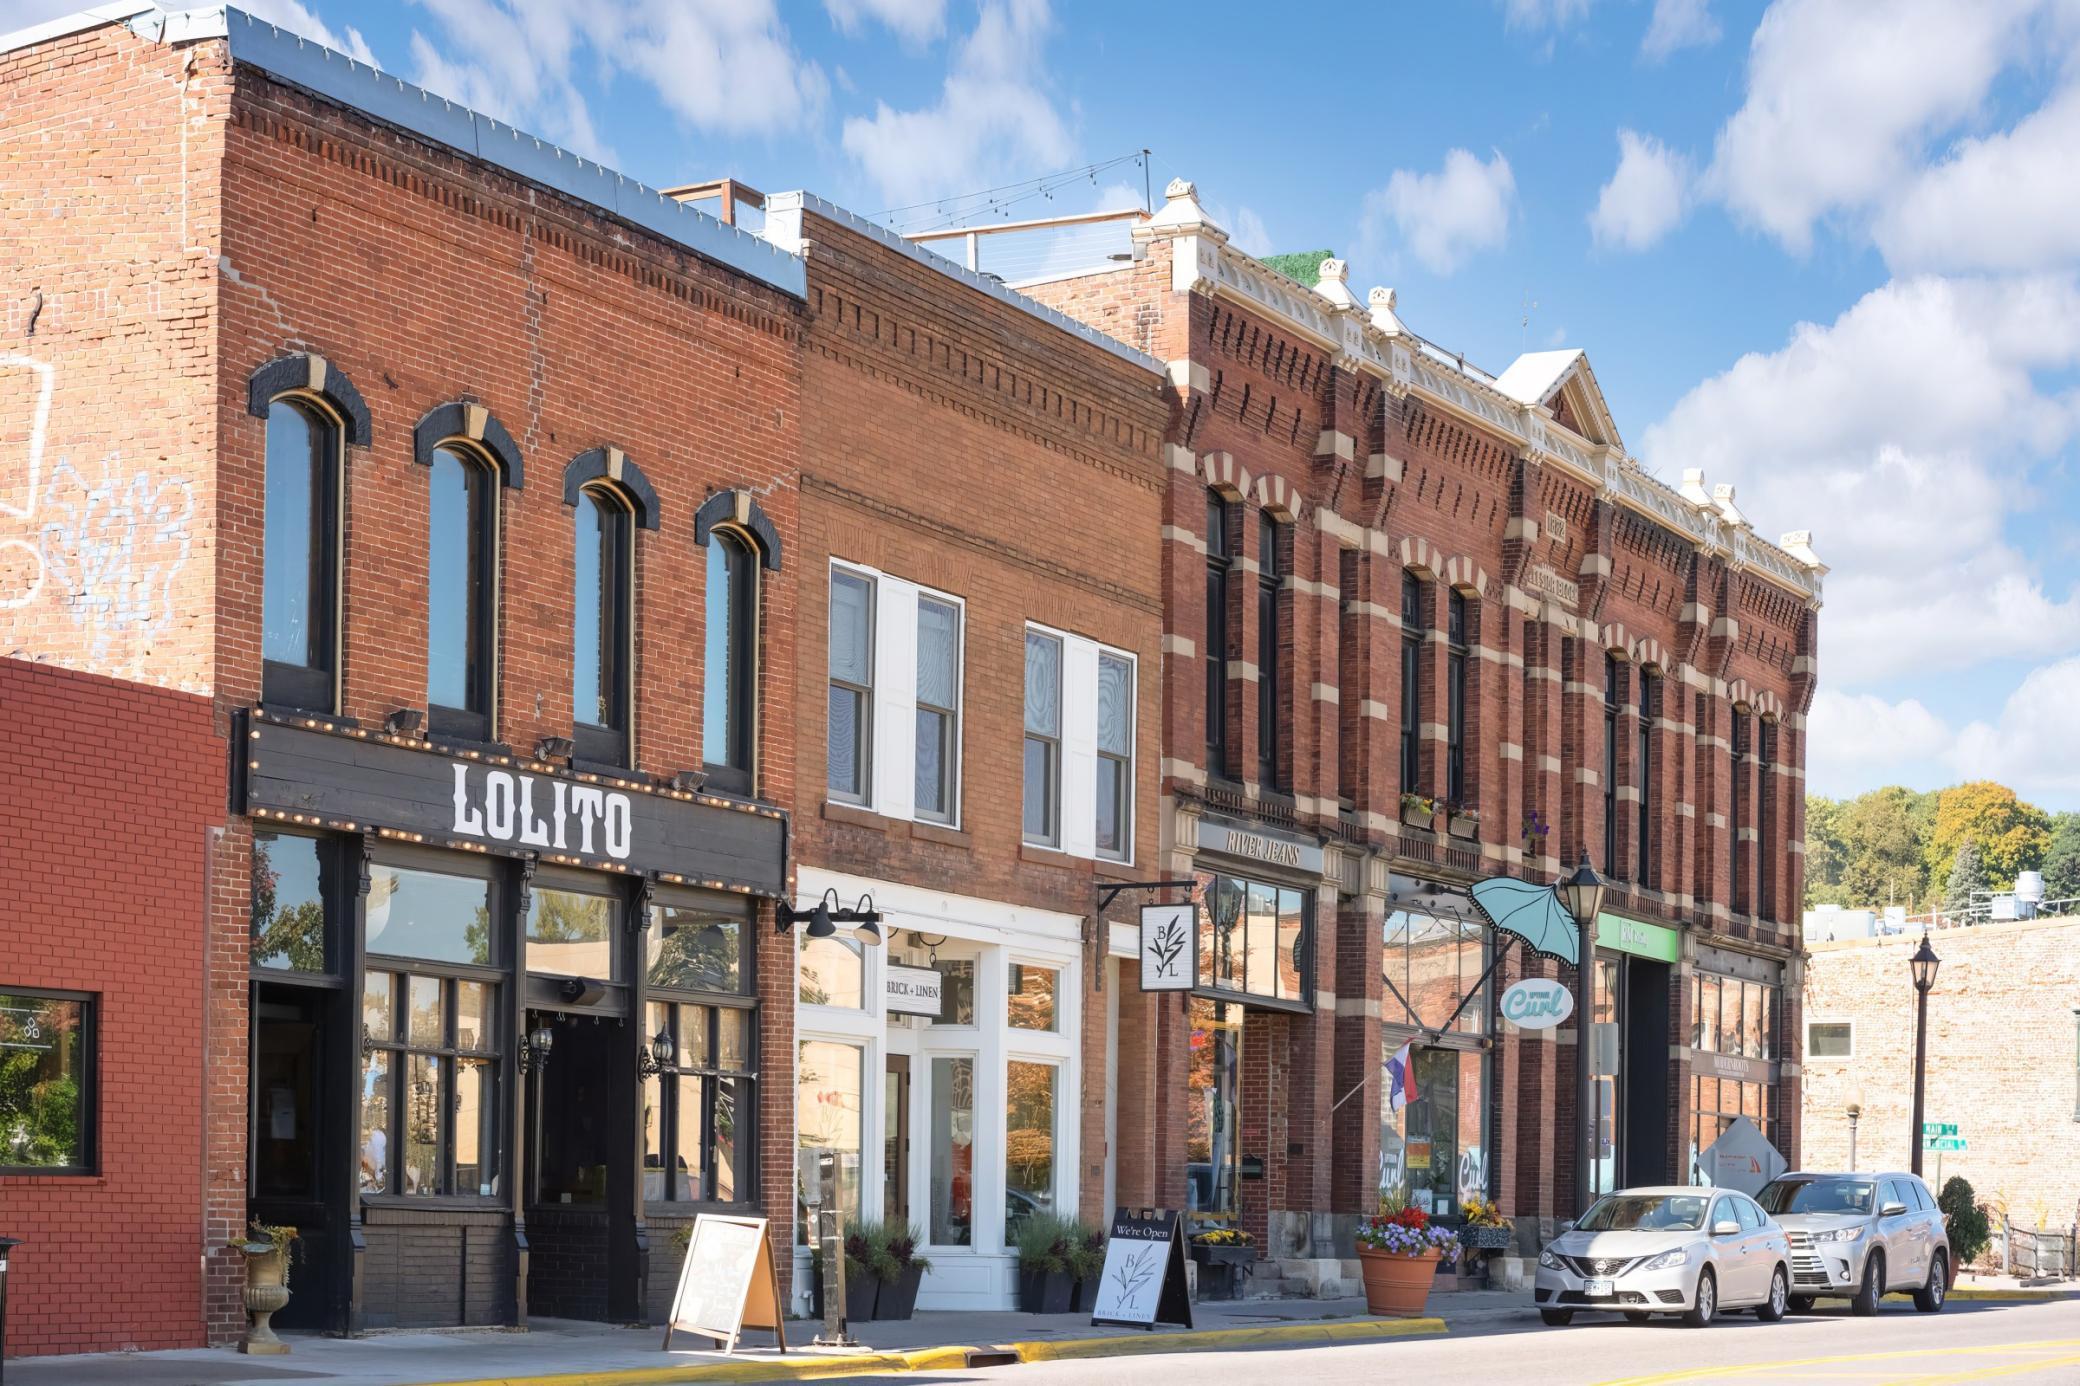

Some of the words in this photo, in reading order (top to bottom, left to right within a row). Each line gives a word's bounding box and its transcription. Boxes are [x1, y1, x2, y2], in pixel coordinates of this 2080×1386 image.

[452, 763, 632, 859] LOLITO
[1227, 831, 1263, 858] RIVER
[1264, 840, 1299, 865] JEANS
[887, 981, 908, 995] BRICK
[915, 985, 938, 998] LINEN
[1504, 986, 1563, 1020] Curl
[1459, 1152, 1488, 1192] Curl
[1116, 1225, 1141, 1236] We're
[1143, 1227, 1169, 1240] Open
